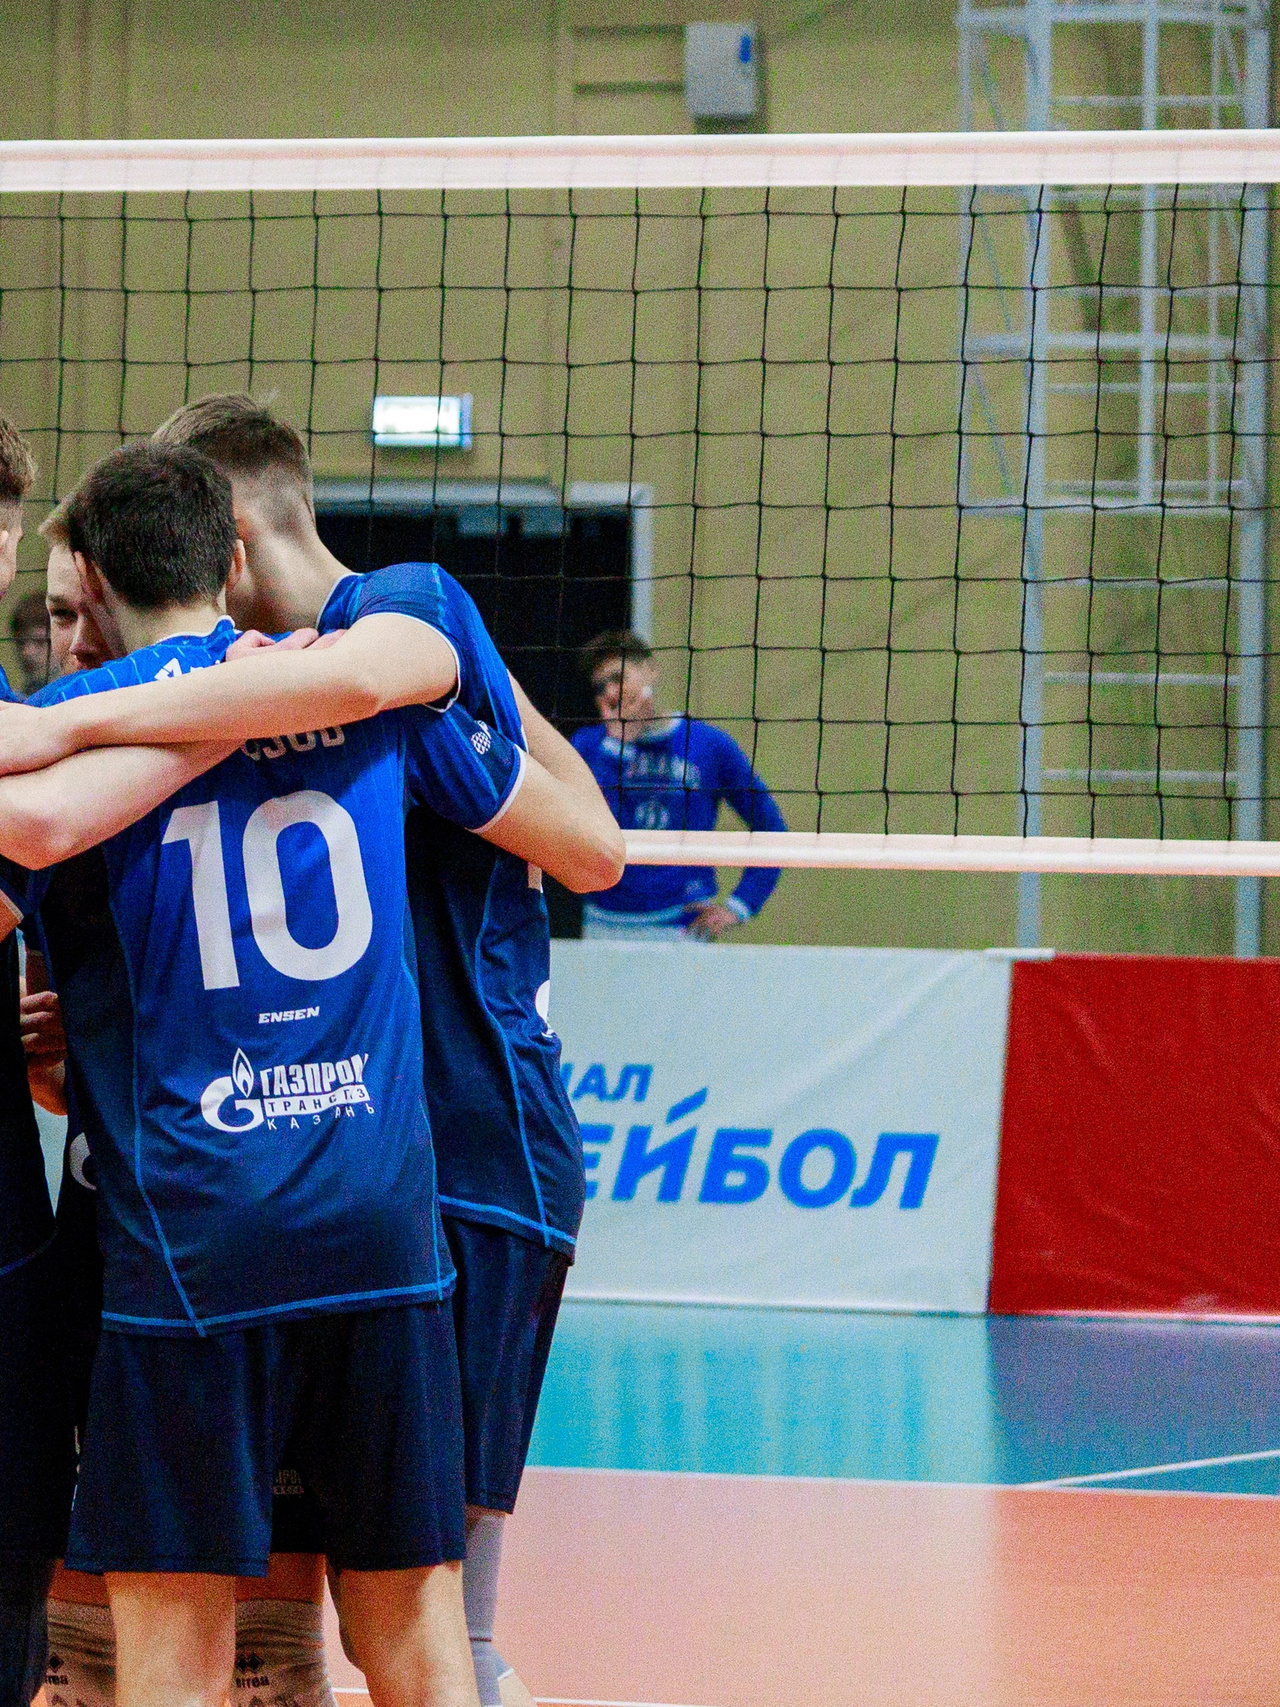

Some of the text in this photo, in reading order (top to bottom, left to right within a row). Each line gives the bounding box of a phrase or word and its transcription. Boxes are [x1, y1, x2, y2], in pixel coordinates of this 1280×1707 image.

[162, 790, 373, 990] 10
[258, 1006, 320, 1024] ENSEN
[267, 1088, 366, 1113] ТРАНСГЗ
[267, 1103, 375, 1131] КАЗАНЬ
